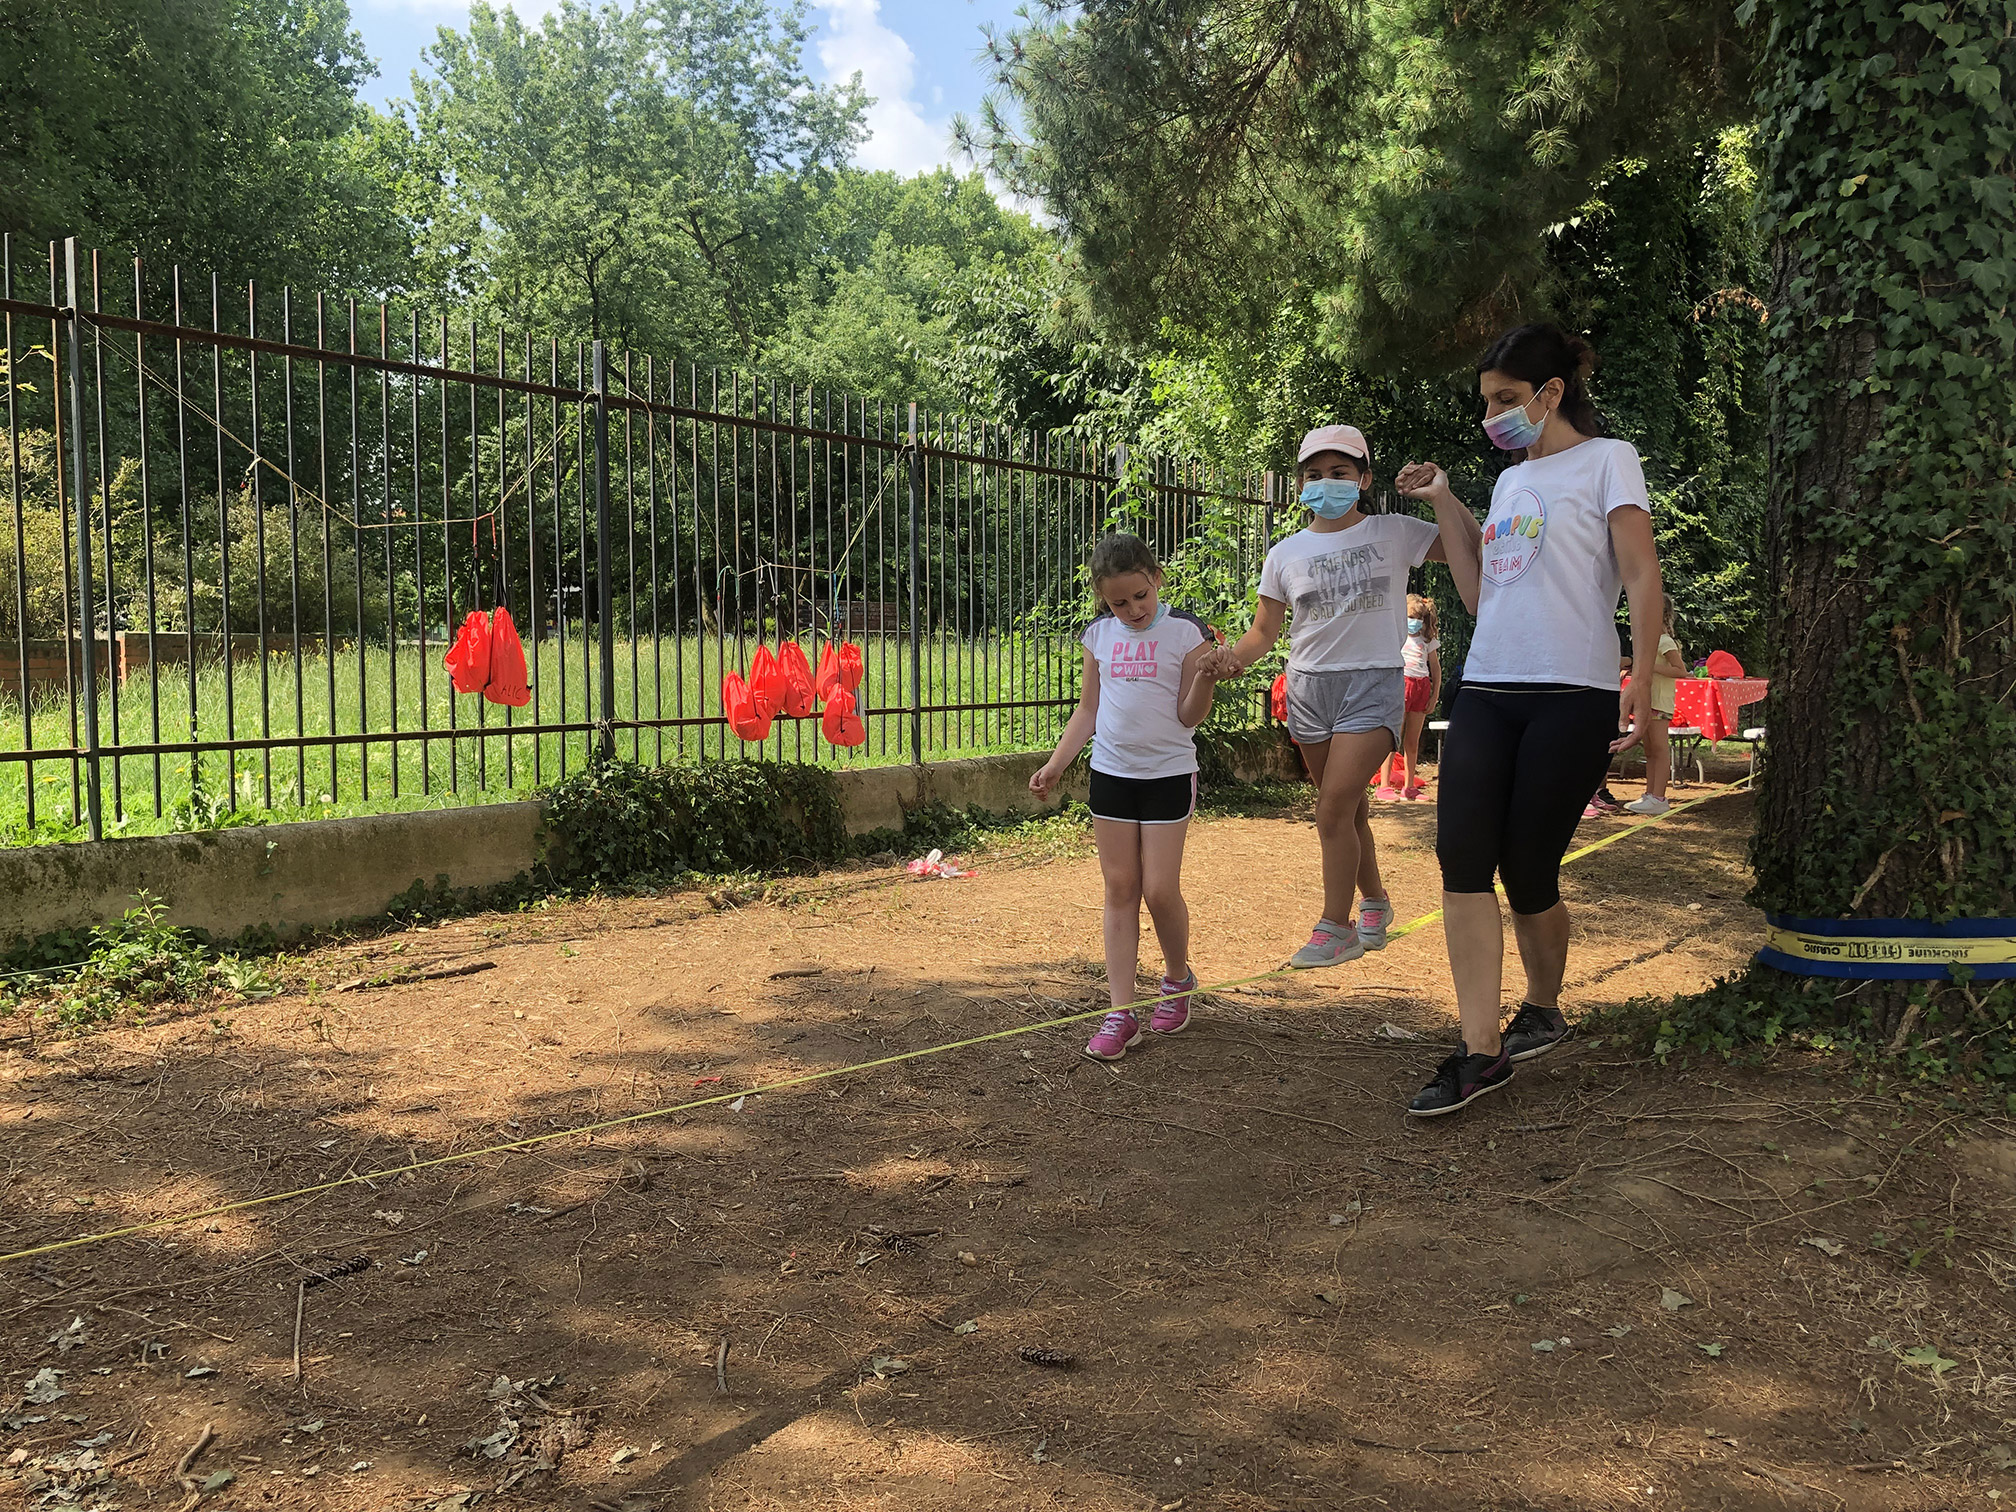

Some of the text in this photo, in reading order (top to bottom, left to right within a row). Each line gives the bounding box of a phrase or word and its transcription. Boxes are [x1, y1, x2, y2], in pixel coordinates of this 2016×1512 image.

[1481, 514, 1544, 547] AMPUS
[1314, 550, 1366, 575] FRIENDS
[1490, 555, 1522, 575] TEAM
[1359, 594, 1384, 609] NEED
[1111, 640, 1158, 662] PLAY
[1123, 664, 1144, 675] WIN
[1804, 944, 1841, 956] CLASSIC
